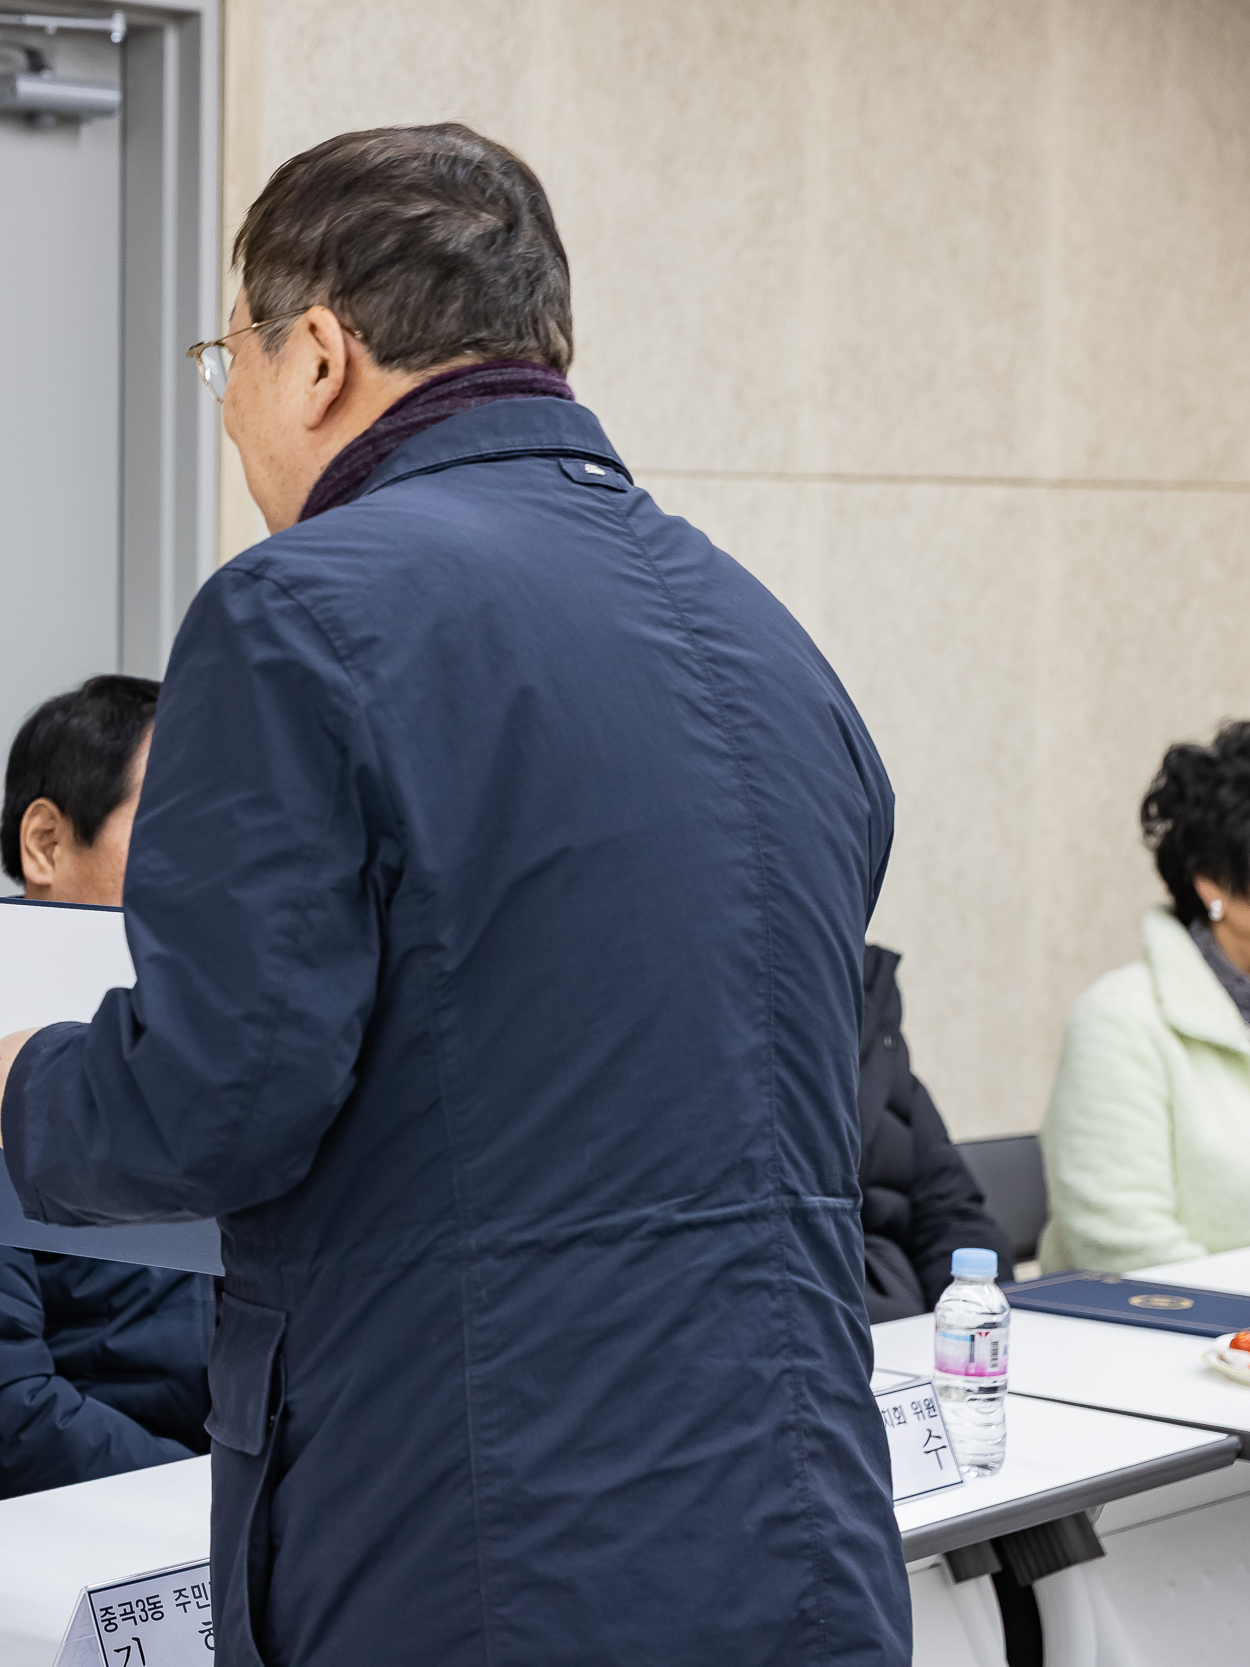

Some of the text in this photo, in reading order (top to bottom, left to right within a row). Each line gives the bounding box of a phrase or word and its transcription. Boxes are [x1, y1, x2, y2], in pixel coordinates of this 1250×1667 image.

[910, 1397, 938, 1421] 위원
[922, 1428, 947, 1471] 수
[100, 1582, 211, 1633] 중곡3동 주민
